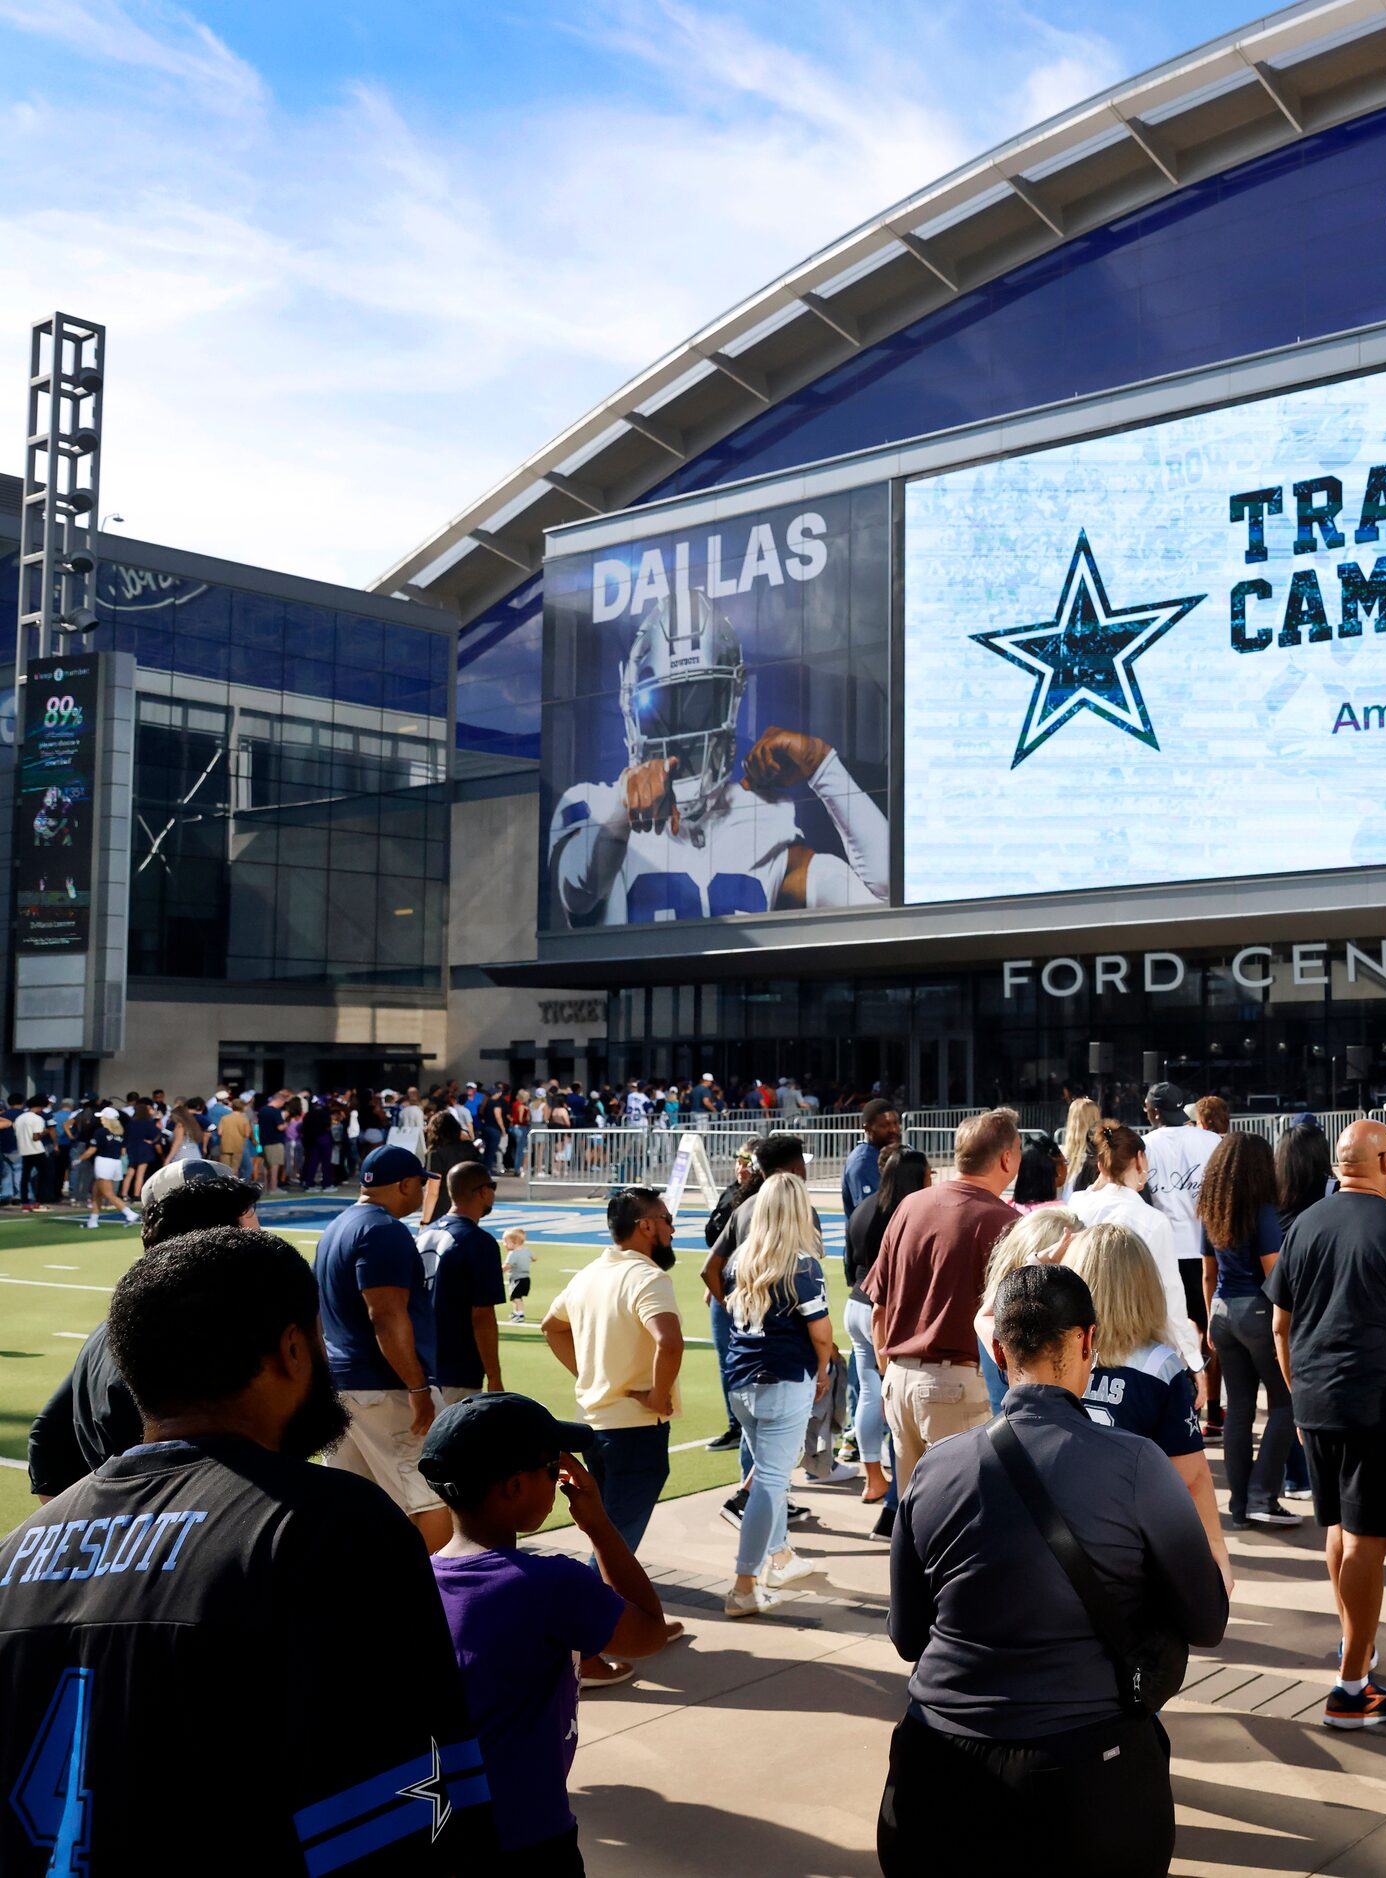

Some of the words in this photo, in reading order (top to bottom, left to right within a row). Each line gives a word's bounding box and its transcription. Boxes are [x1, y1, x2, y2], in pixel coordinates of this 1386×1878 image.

[592, 511, 828, 624] DALLAS
[44, 695, 84, 728] 89%
[1002, 951, 1185, 999] FORD
[0, 1510, 208, 1587] PRESCOTT
[9, 1666, 95, 1878] 4
